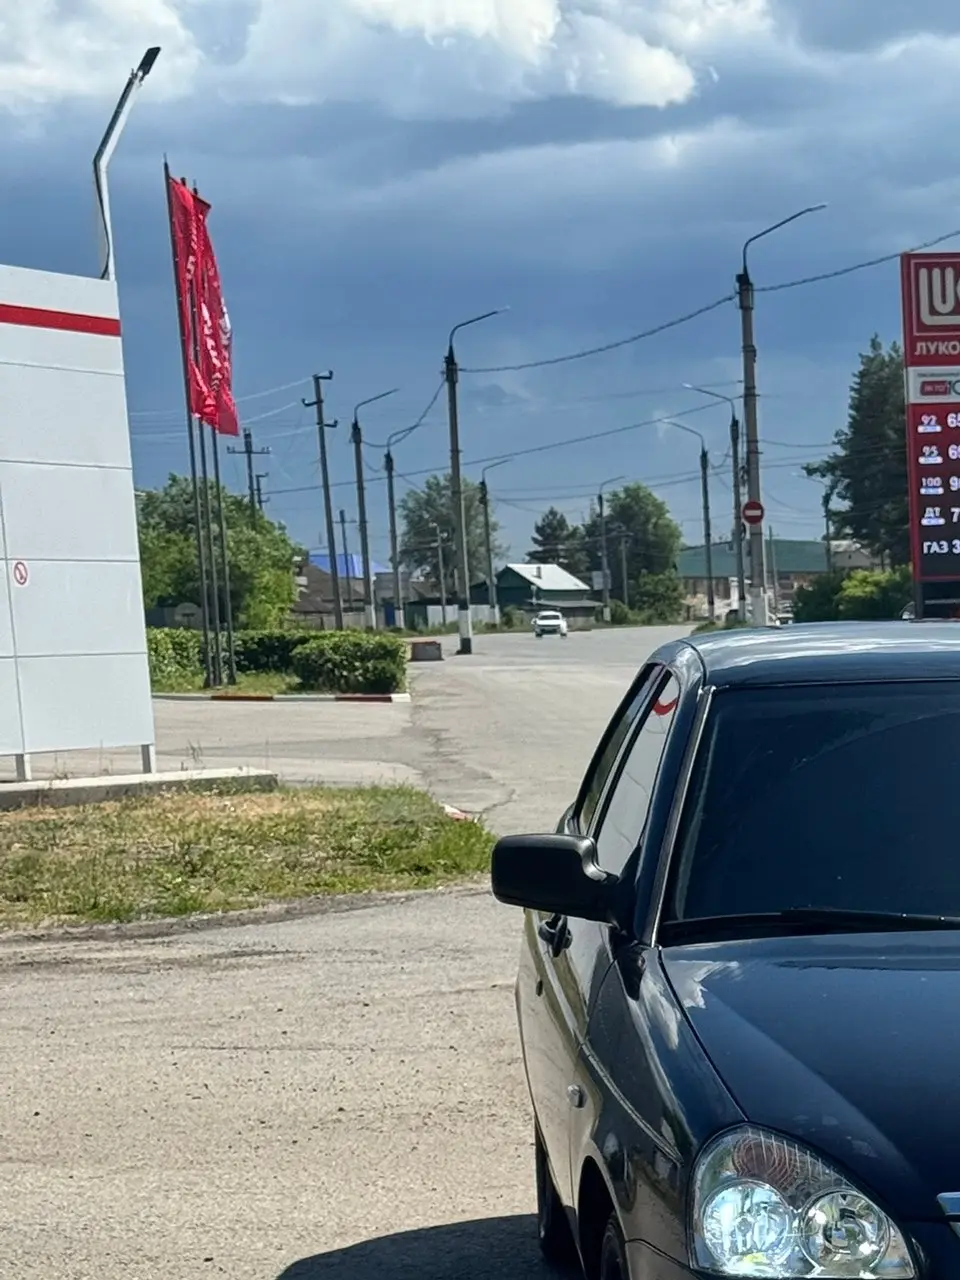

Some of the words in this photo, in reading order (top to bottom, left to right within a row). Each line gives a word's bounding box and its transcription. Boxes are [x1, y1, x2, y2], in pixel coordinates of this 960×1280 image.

[921, 414, 937, 425] 92
[922, 445, 938, 457] 95
[921, 477, 942, 487] 100
[924, 507, 941, 518] ДТ
[923, 541, 949, 554] ГАЗ
